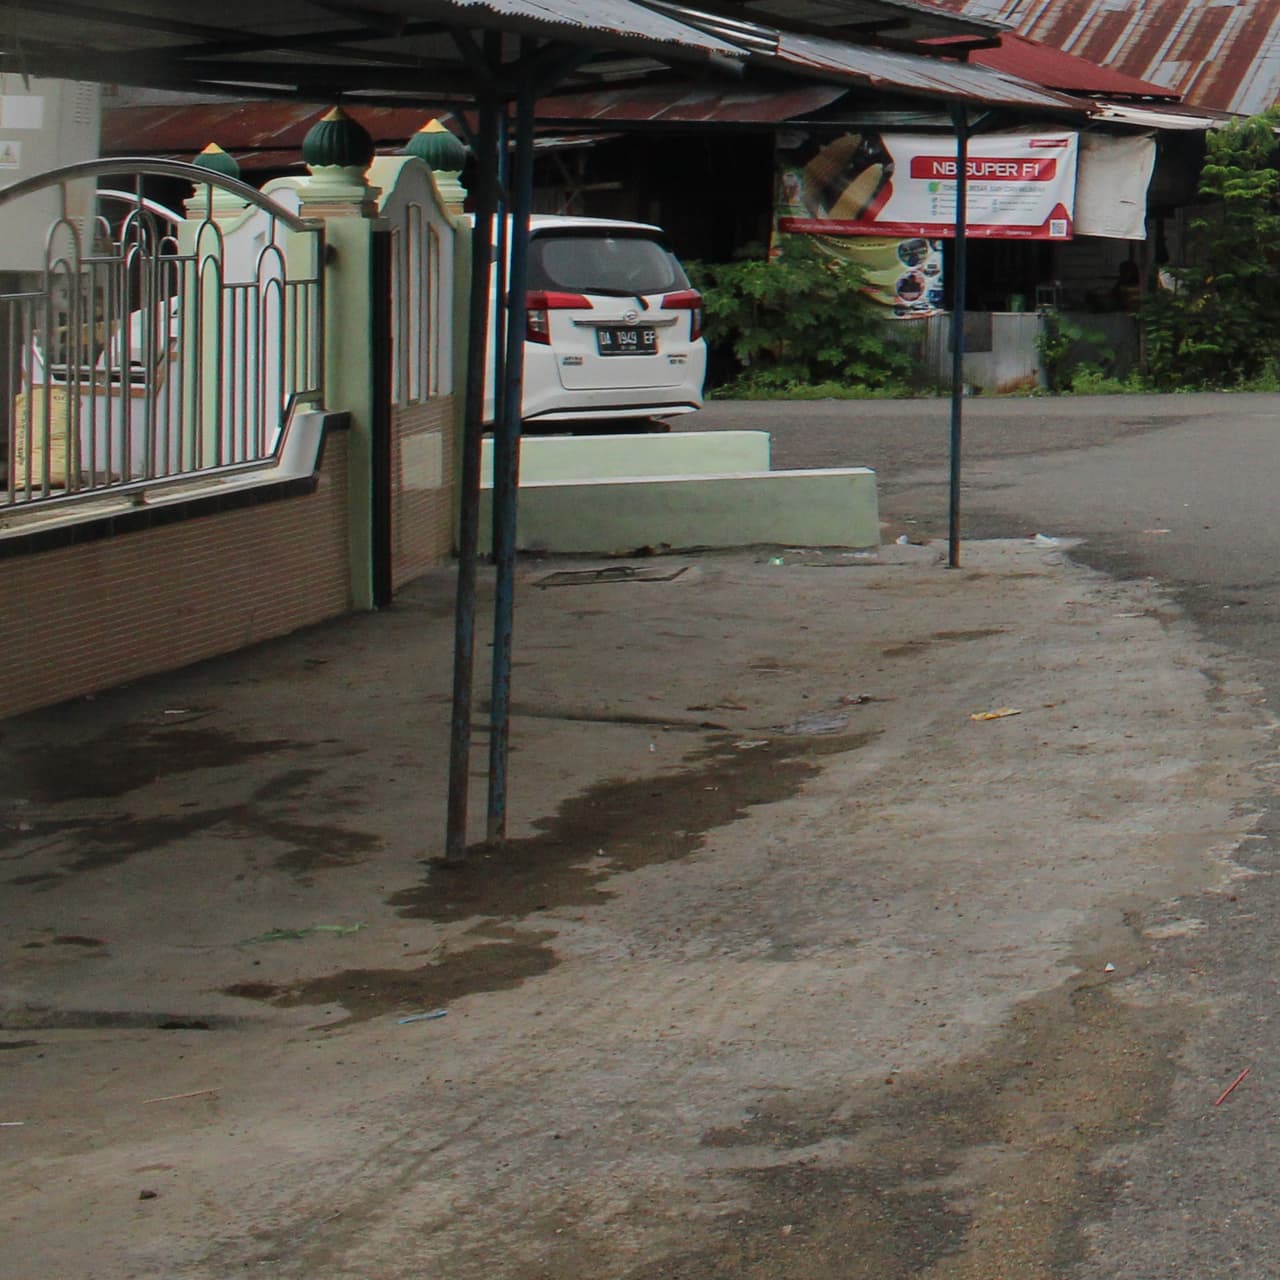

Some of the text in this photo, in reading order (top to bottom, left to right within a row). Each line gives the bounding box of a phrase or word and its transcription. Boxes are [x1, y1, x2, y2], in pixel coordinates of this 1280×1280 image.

[933, 162, 1039, 177] NB SUPER F1
[600, 331, 612, 344] DA
[617, 331, 637, 344] 1949
